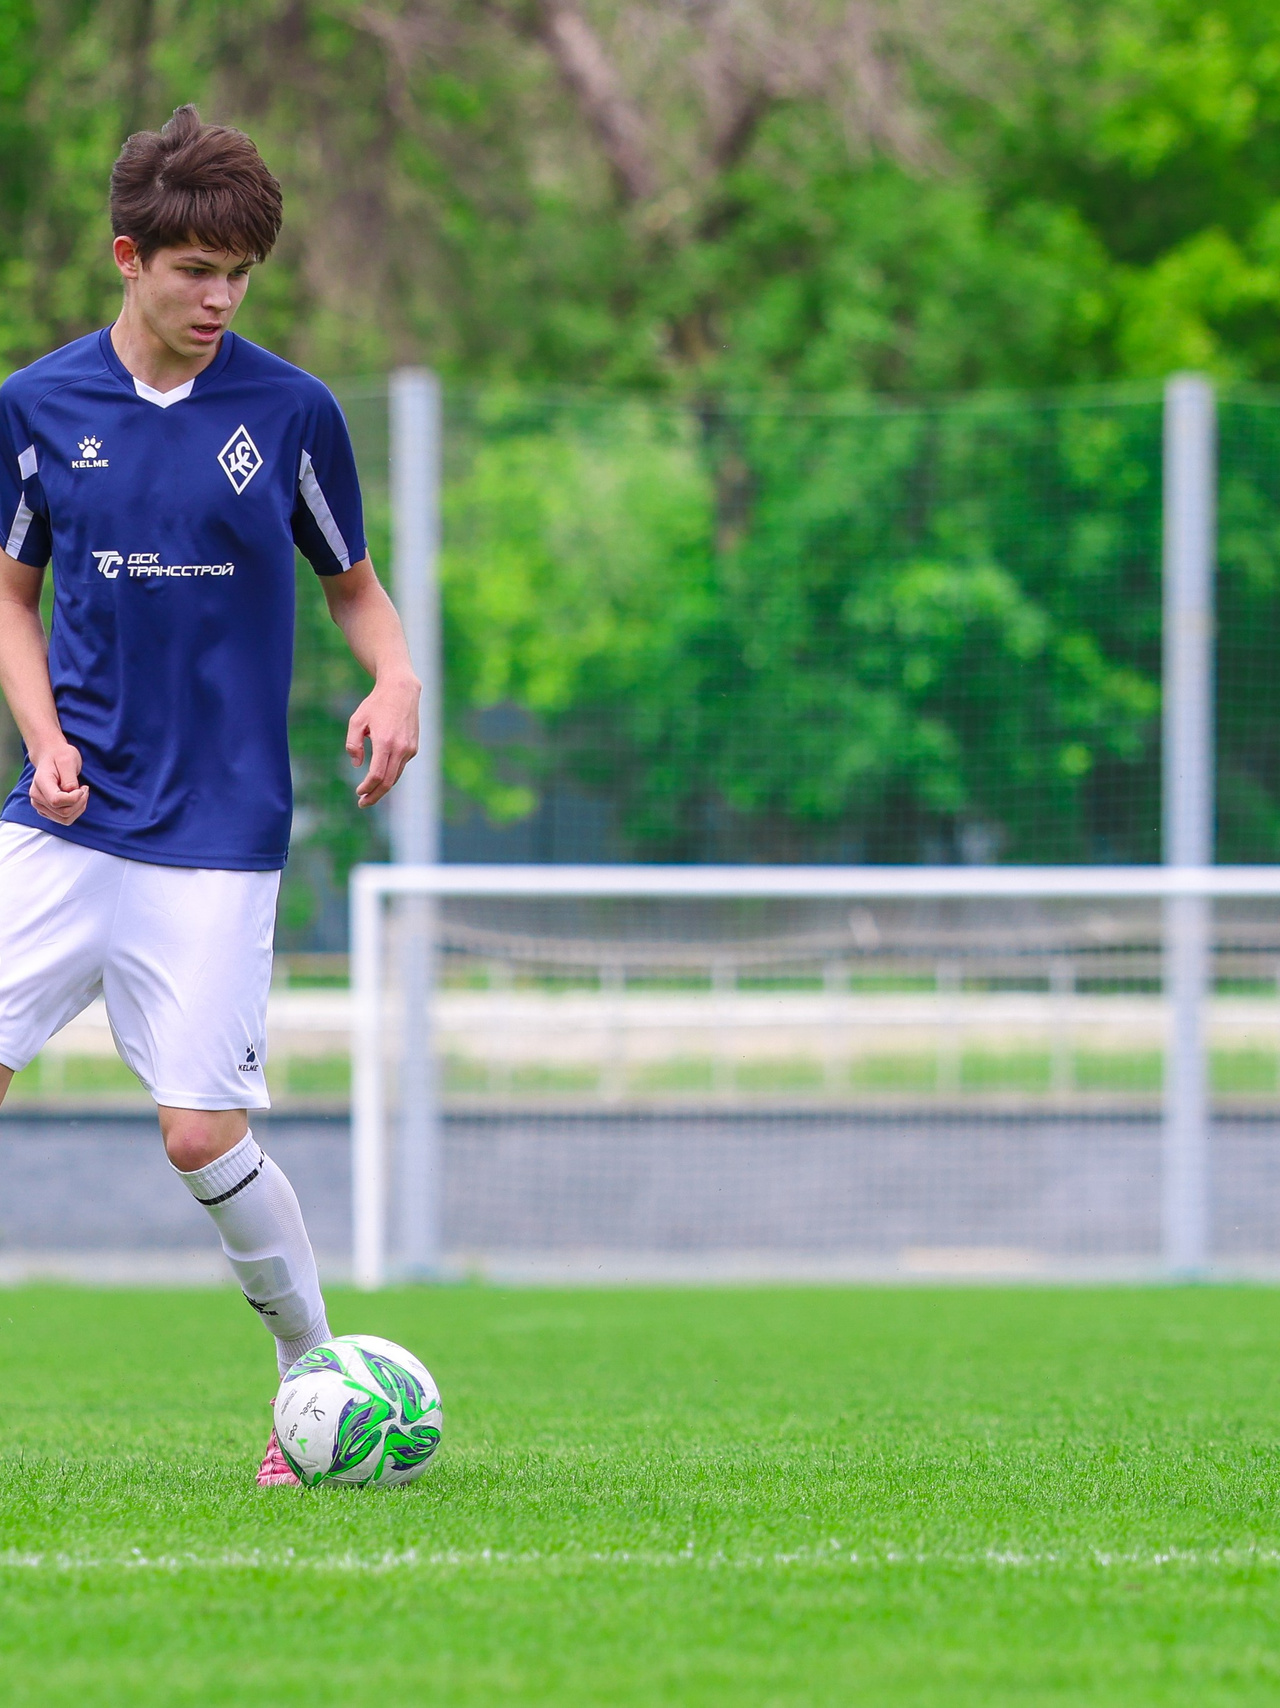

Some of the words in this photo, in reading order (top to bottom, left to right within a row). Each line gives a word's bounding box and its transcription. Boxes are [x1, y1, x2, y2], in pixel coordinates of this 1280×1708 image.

[71, 459, 109, 469] KELME
[127, 553, 160, 564] ДСК
[127, 562, 235, 577] ТРАНССТРОЙ
[237, 1064, 259, 1072] KELME
